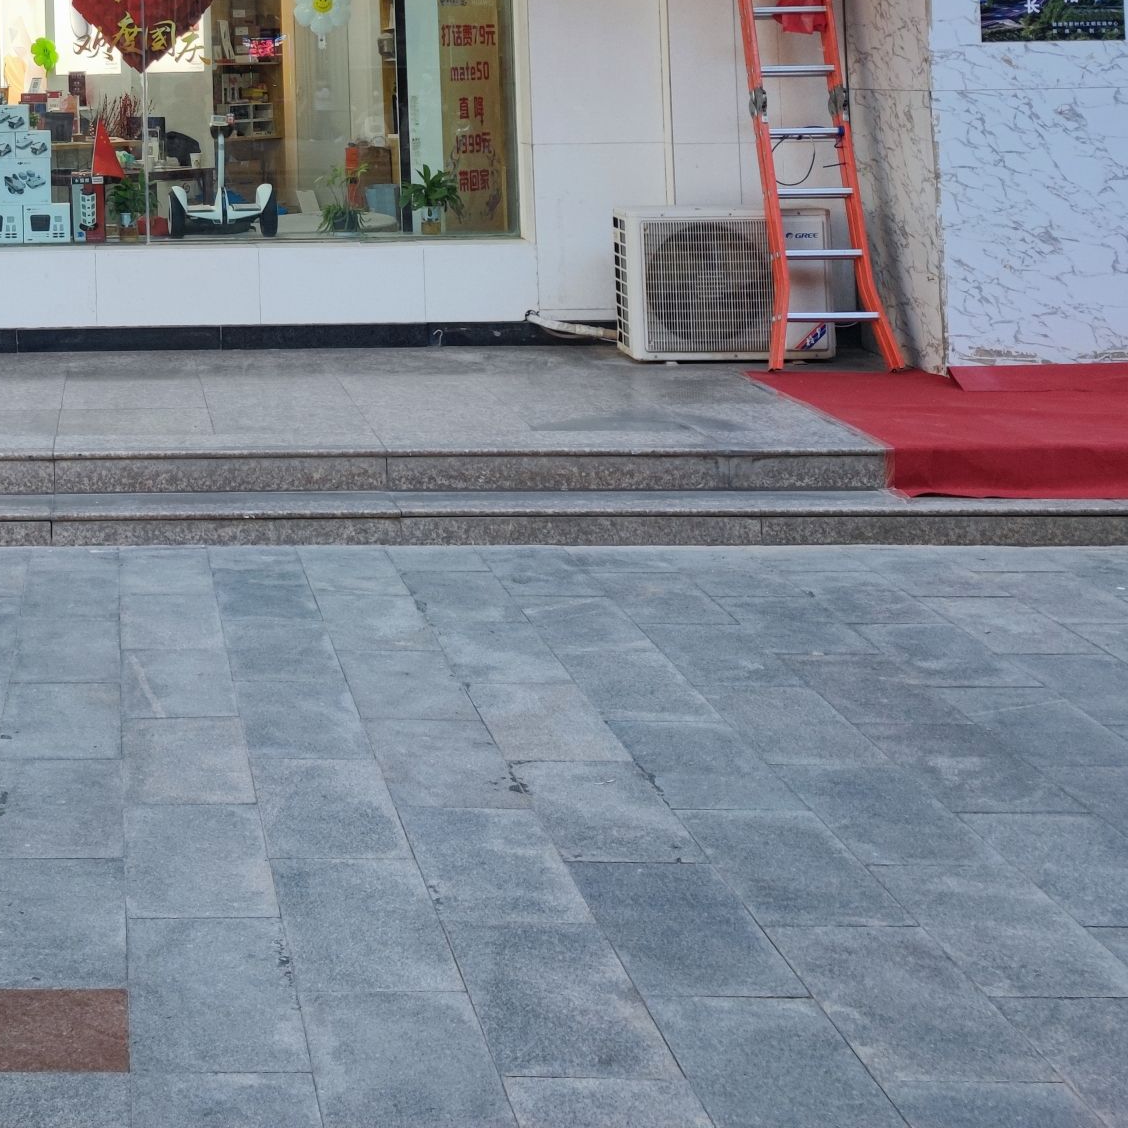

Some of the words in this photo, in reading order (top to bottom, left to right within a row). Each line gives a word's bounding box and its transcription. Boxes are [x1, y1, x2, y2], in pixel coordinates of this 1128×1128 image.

[441, 24, 496, 47] 打话费79元
[450, 62, 490, 81] mate50
[459, 169, 490, 192] 带回家
